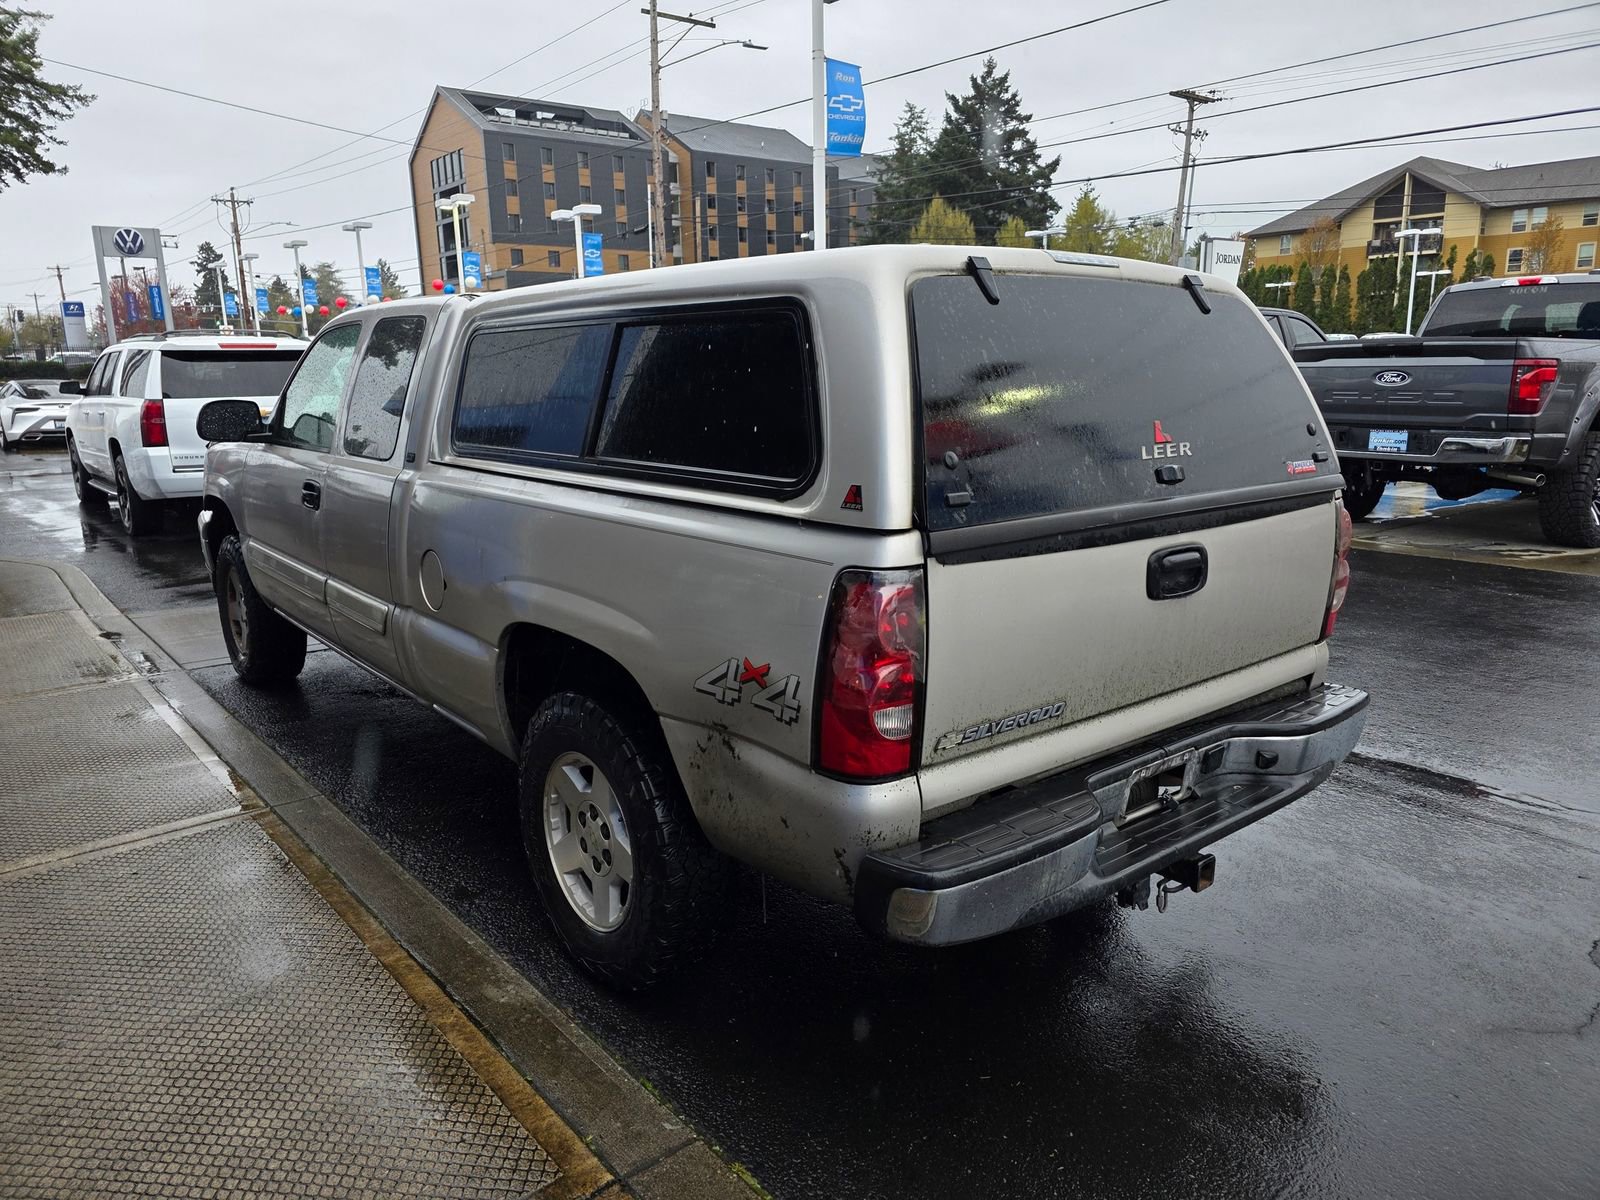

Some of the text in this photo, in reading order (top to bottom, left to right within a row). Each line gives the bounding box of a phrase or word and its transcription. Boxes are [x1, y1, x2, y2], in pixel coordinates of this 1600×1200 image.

[835, 72, 855, 83] Ron
[828, 113, 864, 121] CHEVROLET
[829, 132, 864, 144] Tonkin
[1216, 252, 1241, 264] JORDAN
[1381, 372, 1401, 382] Ford
[1141, 441, 1192, 461] LEER
[961, 701, 1067, 744] SILVERADO
